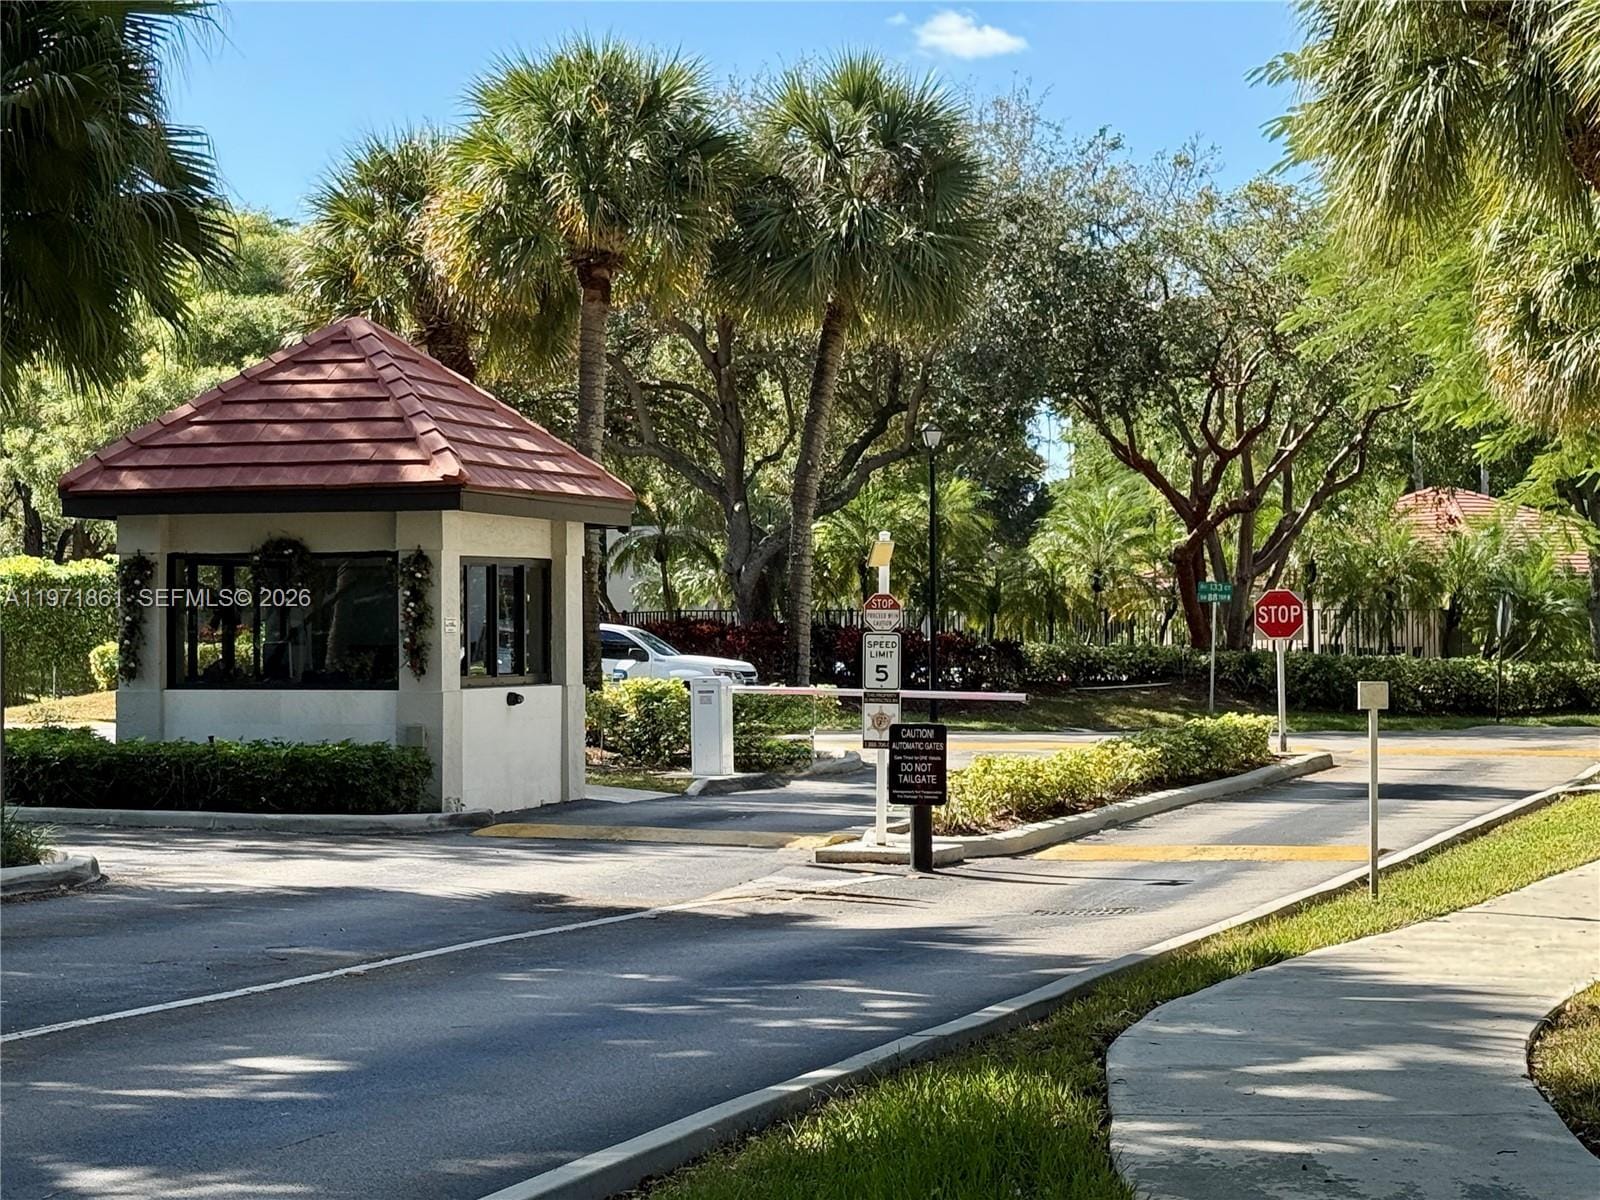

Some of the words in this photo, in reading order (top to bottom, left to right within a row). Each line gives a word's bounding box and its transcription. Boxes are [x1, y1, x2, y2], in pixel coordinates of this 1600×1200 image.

[871, 598, 894, 609] STOP
[1258, 605, 1301, 624] STOP
[867, 640, 897, 649] SPEED
[870, 650, 895, 659] LIMIT
[875, 664, 889, 682] 5
[891, 741, 924, 750] AUTOMATIC
[924, 742, 944, 751] GATES
[900, 762, 913, 772] DO
[914, 762, 932, 773] NOT
[898, 774, 937, 784] TAILGATE
